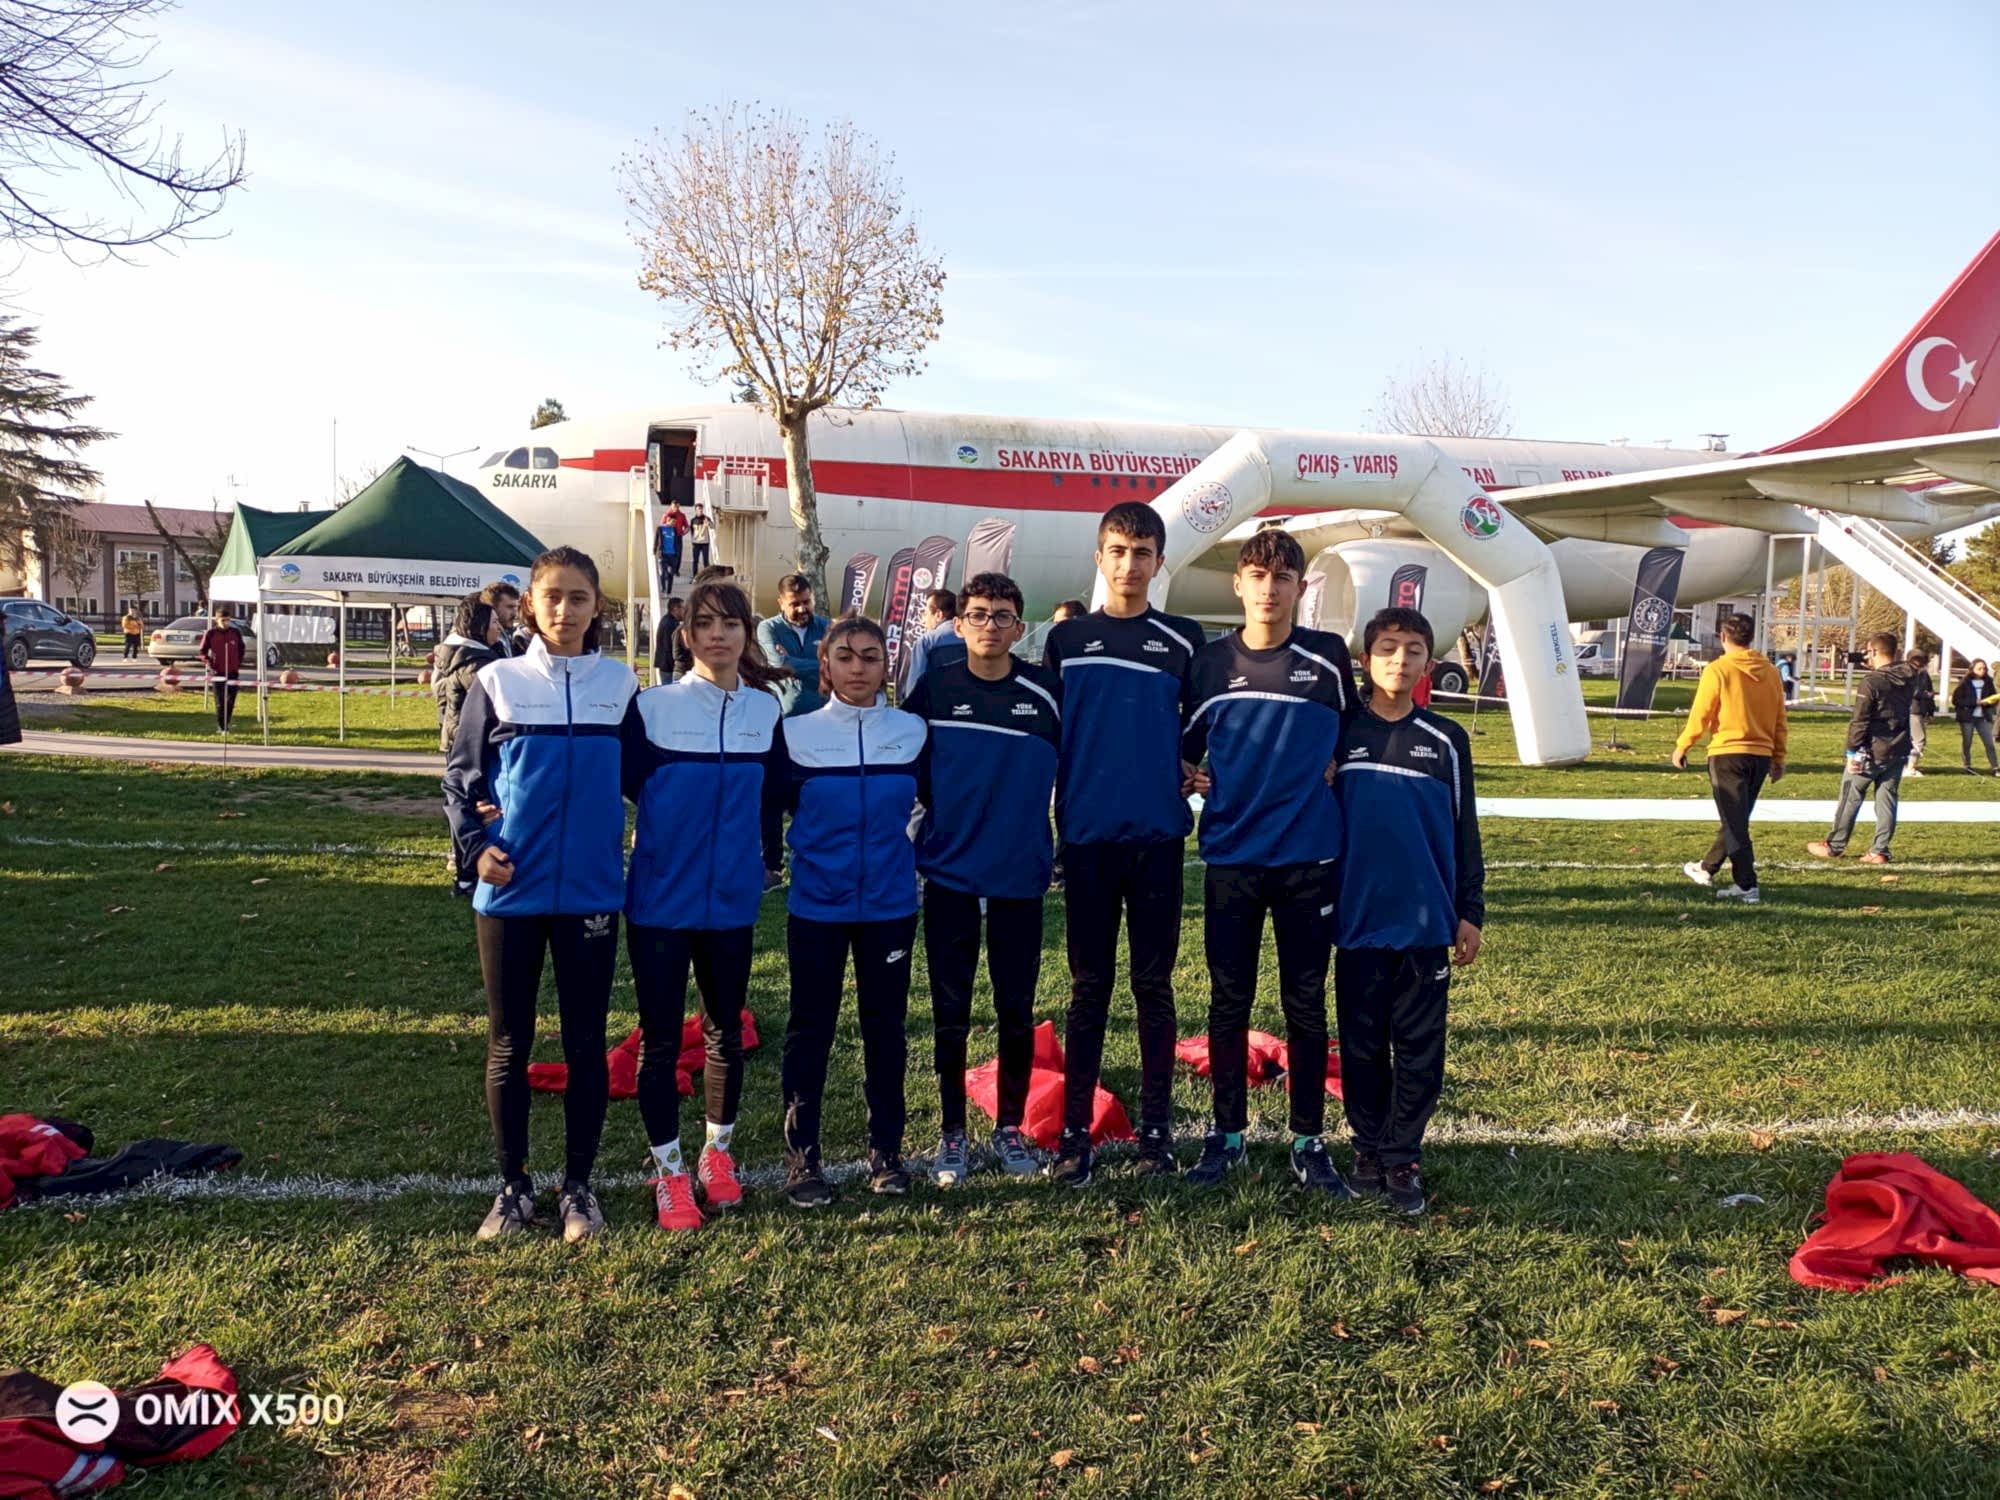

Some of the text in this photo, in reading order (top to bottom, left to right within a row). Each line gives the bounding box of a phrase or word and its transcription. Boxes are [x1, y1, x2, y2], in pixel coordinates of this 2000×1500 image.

[998, 449, 1085, 471] SAKARYA
[1298, 453, 1340, 478] ÇIKIŞ
[1353, 454, 1398, 479] VARIŞ
[492, 473, 557, 489] SAKARYA
[322, 571, 481, 589] SAKARYA BÜYÜKŞEHİR BELEDİYESİ
[1550, 621, 1562, 662] TURKCELL
